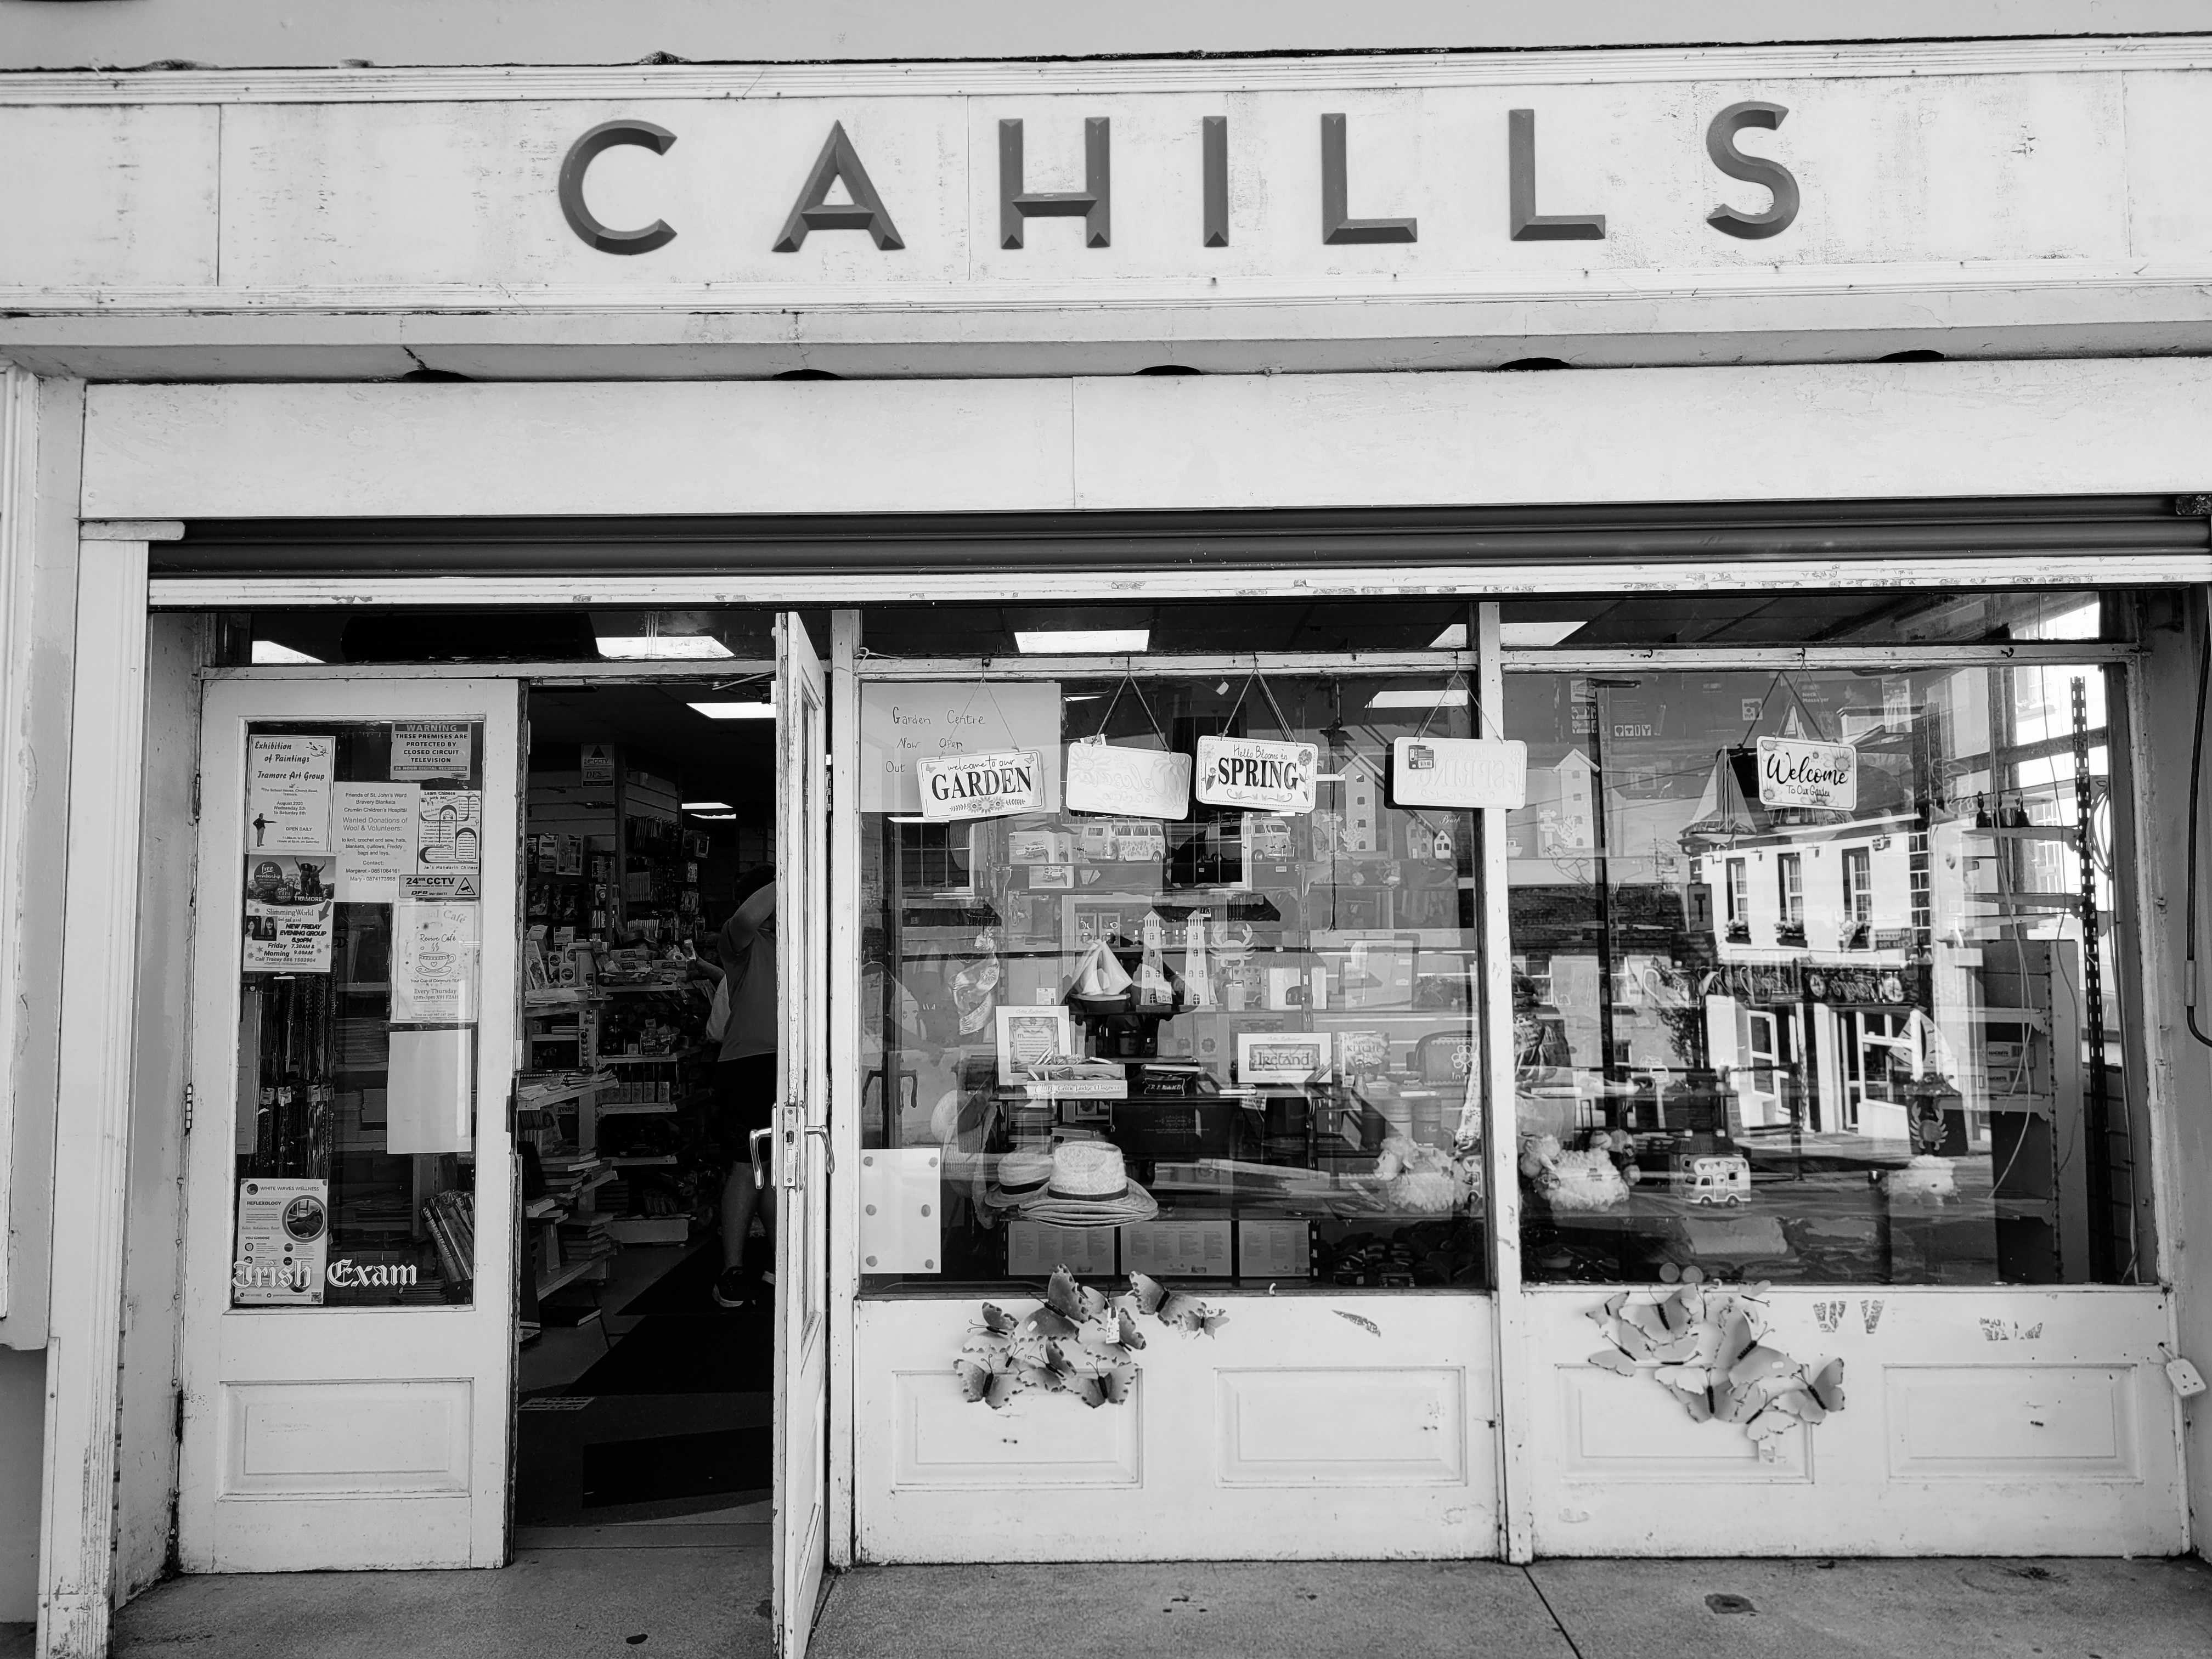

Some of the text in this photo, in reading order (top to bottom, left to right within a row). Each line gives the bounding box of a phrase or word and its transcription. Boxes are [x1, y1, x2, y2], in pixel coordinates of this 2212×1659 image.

[559, 101, 1800, 256] CAHILLS
[893, 707, 985, 725] Garden Centre
[255, 741, 292, 749] Exhibition
[896, 737, 921, 748] Now
[264, 754, 309, 764] of Paintings
[1234, 744, 1287, 760] Hello Blooms in
[885, 760, 905, 772] Out
[947, 758, 988, 771] welcome
[985, 755, 997, 769] to
[1767, 752, 1849, 786] Welcome
[257, 771, 325, 781] Tramore Art Group
[1218, 757, 1299, 790] SPRING
[932, 766, 1032, 800] GARDEN
[1786, 785, 1830, 797] To Our Garden
[262, 864, 273, 873] free
[420, 934, 456, 942] Revive Café
[231, 1259, 417, 1289] Irish Exam
